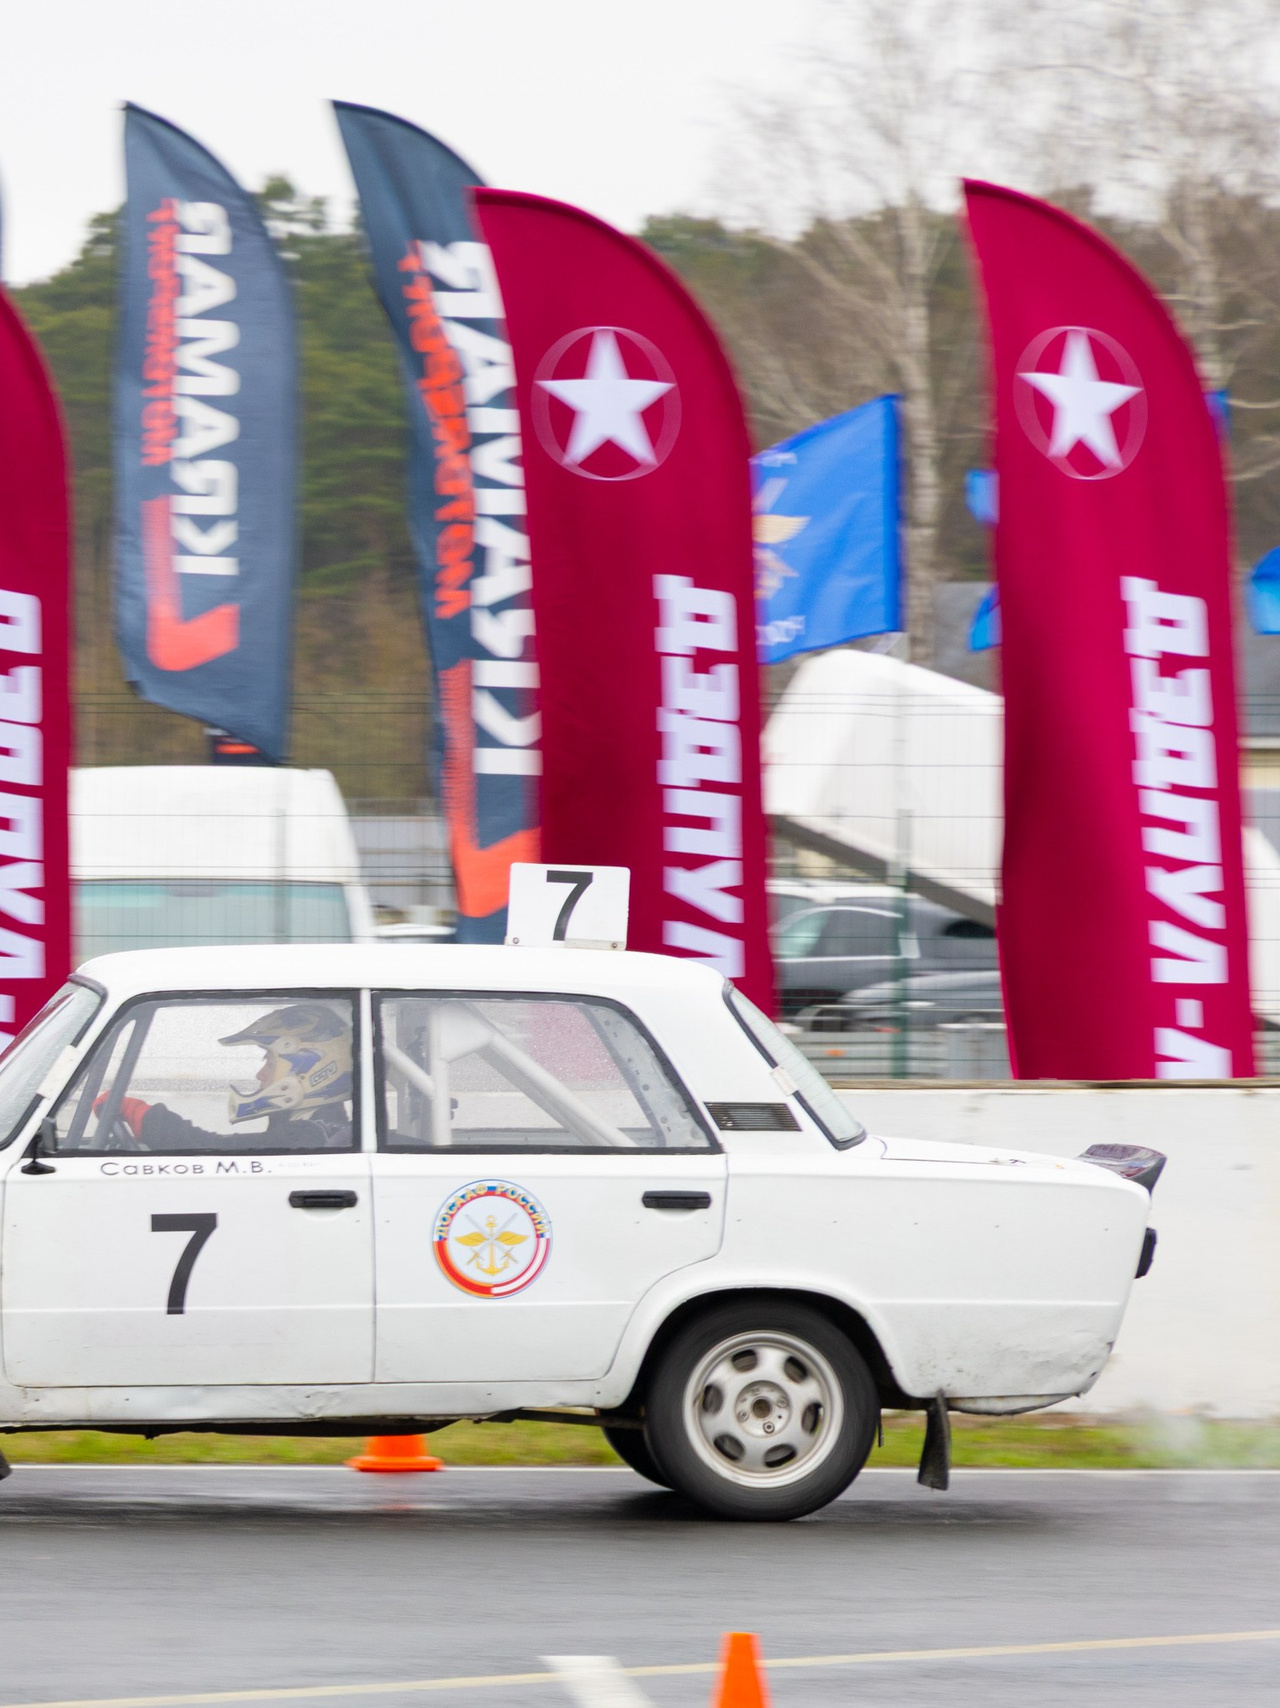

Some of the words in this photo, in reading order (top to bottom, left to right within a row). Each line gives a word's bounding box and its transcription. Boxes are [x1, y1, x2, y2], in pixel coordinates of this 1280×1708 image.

[546, 870, 594, 942] 7
[100, 1162, 205, 1176] Савков
[215, 1161, 273, 1175] М.В.
[435, 1184, 488, 1237] ДОСААФ
[495, 1183, 549, 1235] РОССИИ
[150, 1213, 218, 1315] 7
